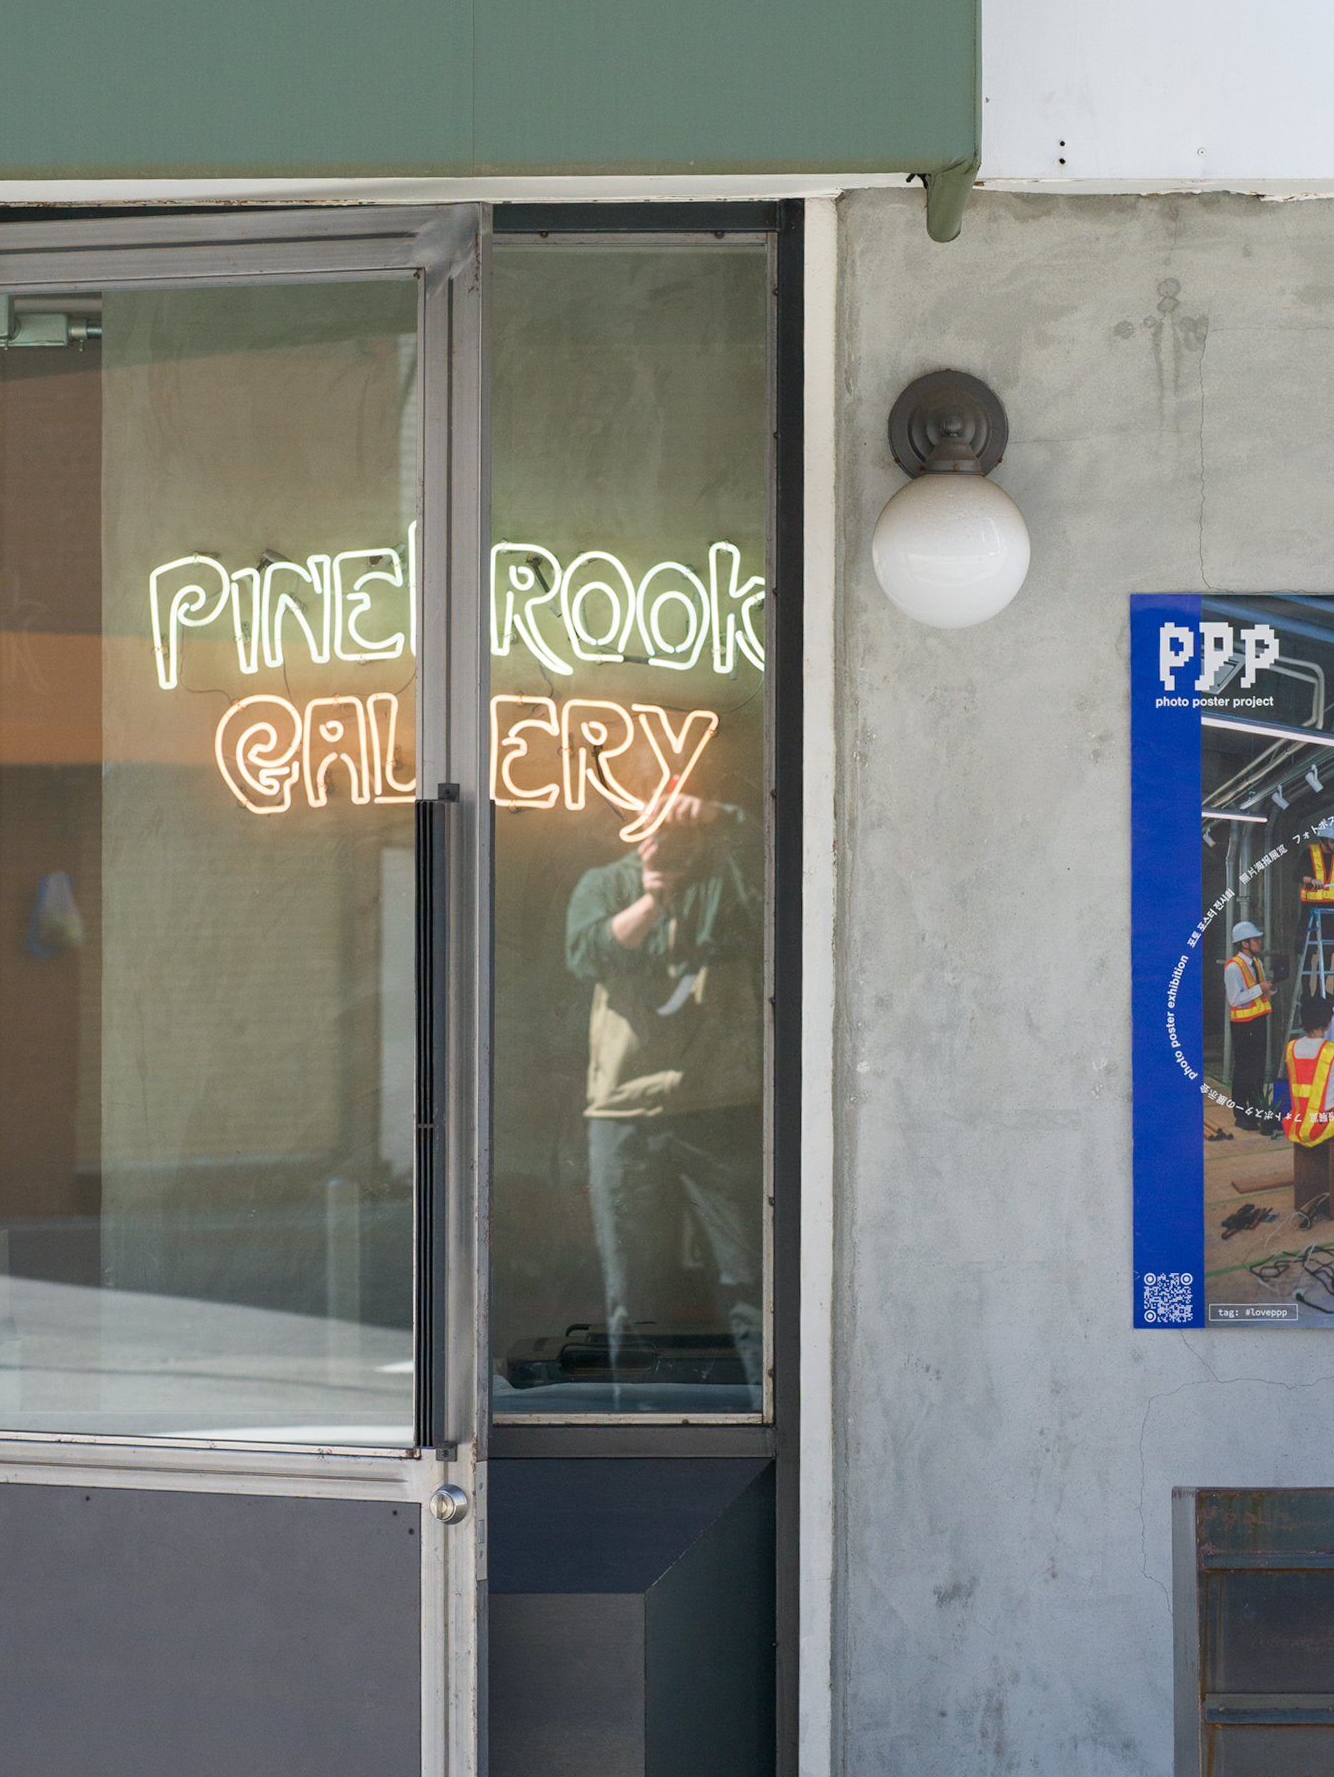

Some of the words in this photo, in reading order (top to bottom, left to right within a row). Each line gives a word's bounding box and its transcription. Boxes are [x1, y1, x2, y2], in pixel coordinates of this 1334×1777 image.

[149, 520, 766, 689] PINEROOK
[1155, 696, 1189, 709] photo
[1192, 697, 1230, 709] poster
[1233, 696, 1274, 709] project
[214, 693, 719, 842] GALERY
[1187, 931, 1202, 949] 포토
[1197, 908, 1218, 933] 포스터
[1213, 887, 1236, 911] 전시회
[1167, 954, 1189, 1009] exhibition
[1166, 1011, 1181, 1049] poster
[1174, 1049, 1199, 1081] photo
[1218, 1308, 1239, 1318] tag:
[1245, 1308, 1288, 1318] #loveppp
